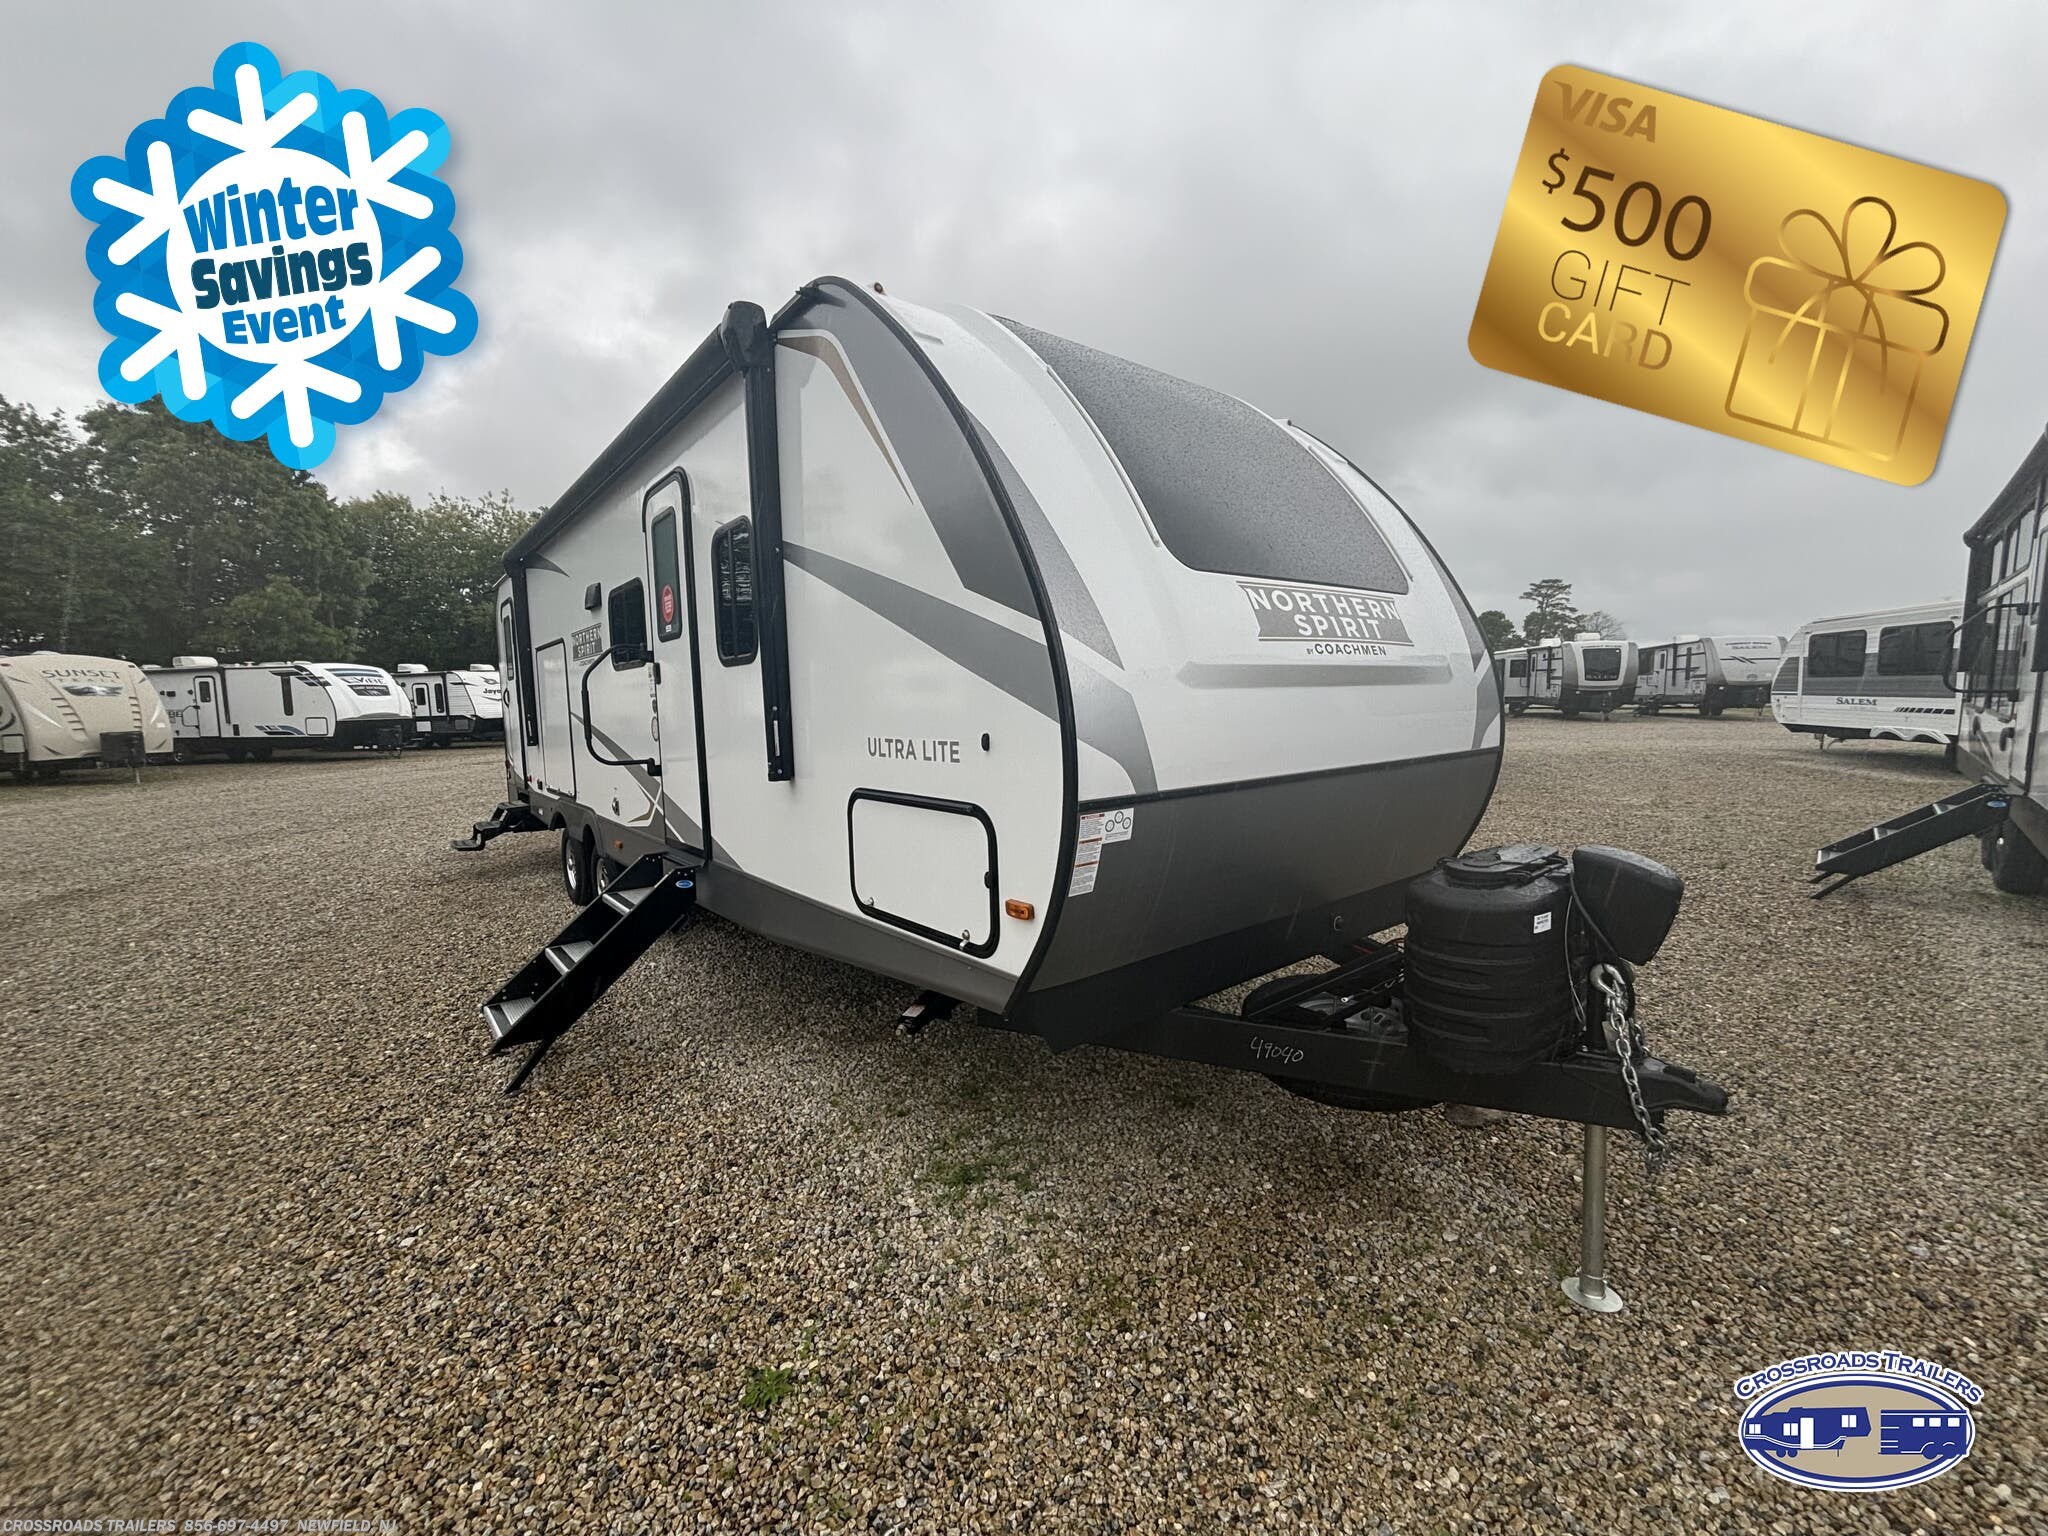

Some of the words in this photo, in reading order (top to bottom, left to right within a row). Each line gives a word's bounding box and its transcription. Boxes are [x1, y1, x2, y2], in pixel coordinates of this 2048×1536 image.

[1245, 587, 1401, 621] NORTHERN
[1293, 614, 1382, 639] SPIRIT
[577, 642, 596, 658] SPIRIT
[1314, 643, 1387, 656] COACHMEN
[41, 669, 121, 679] SUNSET
[1835, 696, 1878, 706] SALEM
[867, 736, 917, 761] ULTRA
[922, 740, 961, 764] LITE
[1250, 1036, 1304, 1065] 49040
